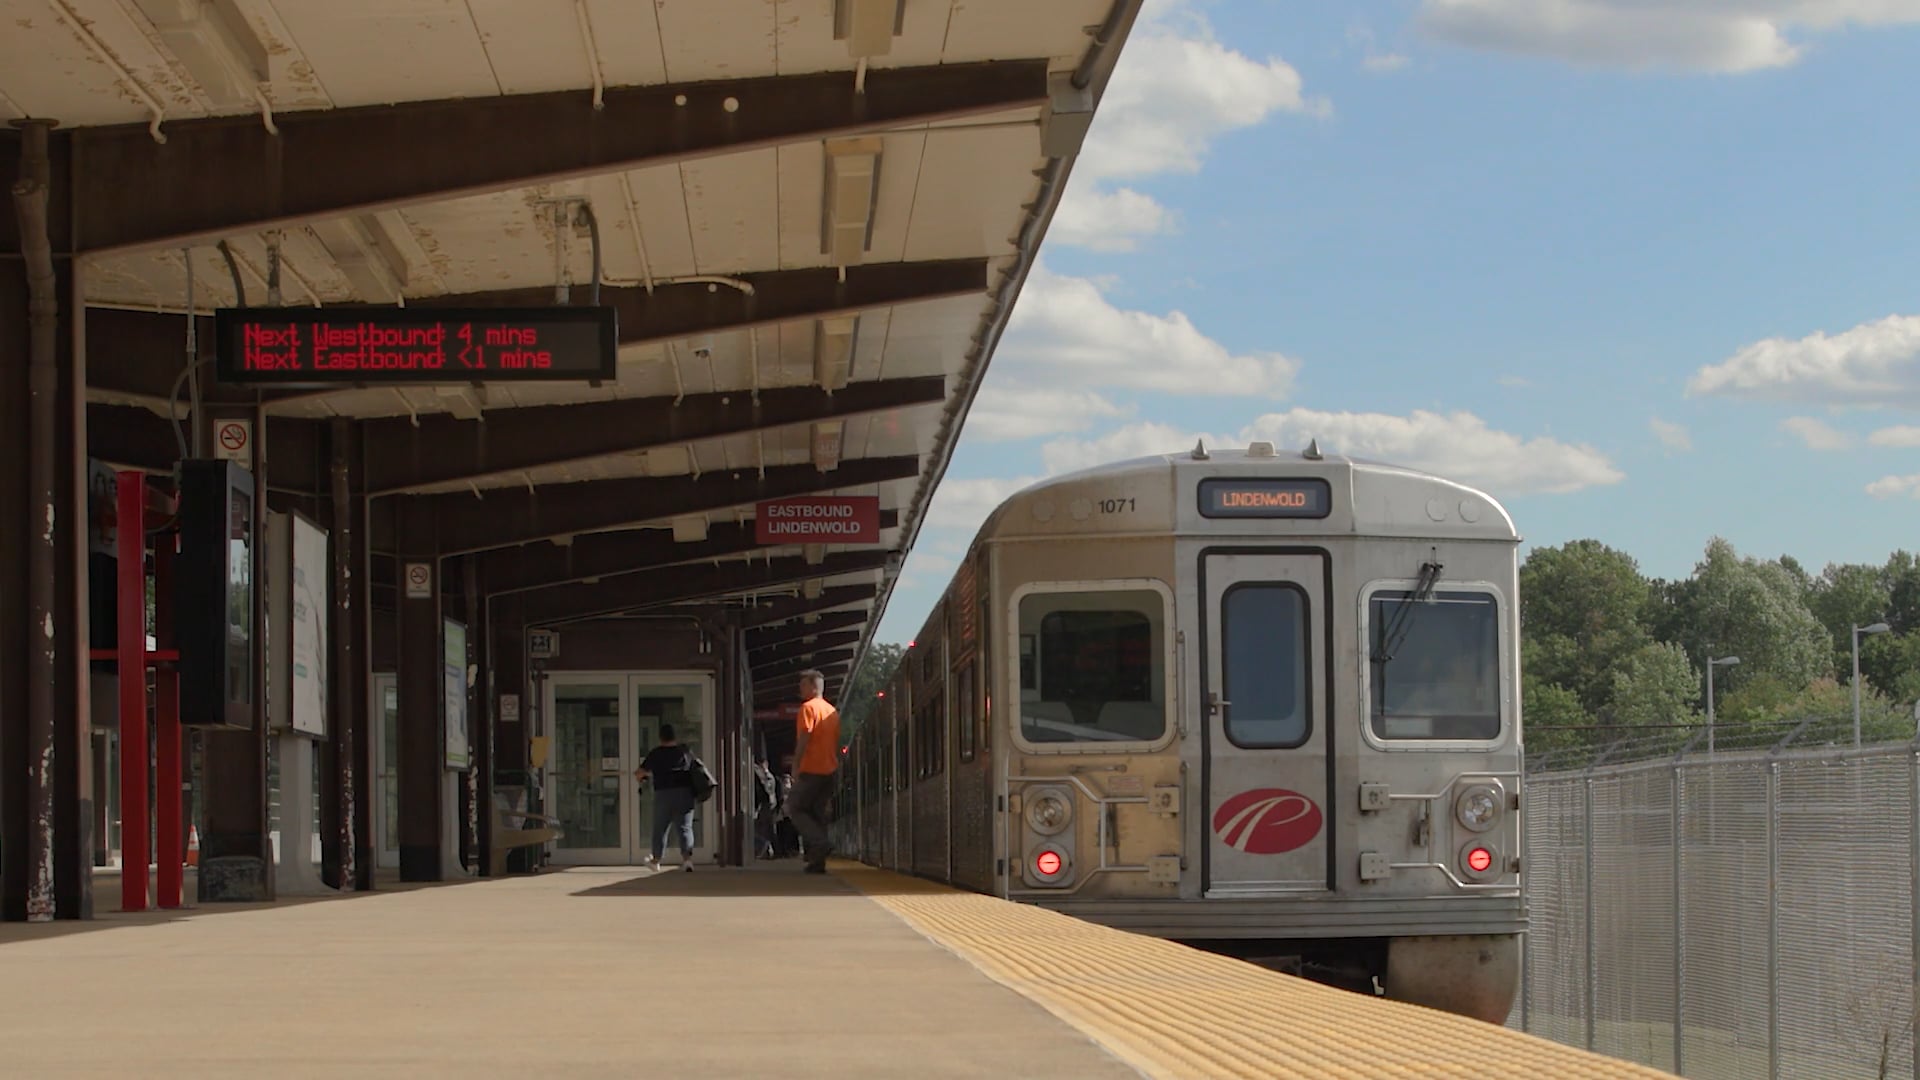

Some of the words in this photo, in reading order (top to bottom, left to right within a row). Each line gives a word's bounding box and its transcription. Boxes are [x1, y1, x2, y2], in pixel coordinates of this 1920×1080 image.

[243, 322, 301, 346] Next
[457, 322, 472, 345] 4
[485, 325, 537, 346] mins
[243, 347, 301, 370] Next
[457, 345, 487, 370] <1
[500, 347, 552, 370] mins
[1098, 498, 1136, 513] 1071
[1222, 492, 1305, 507] LINDENWOLD
[768, 505, 853, 517] EASTBOUND
[768, 521, 860, 533] LINDENWOLD
